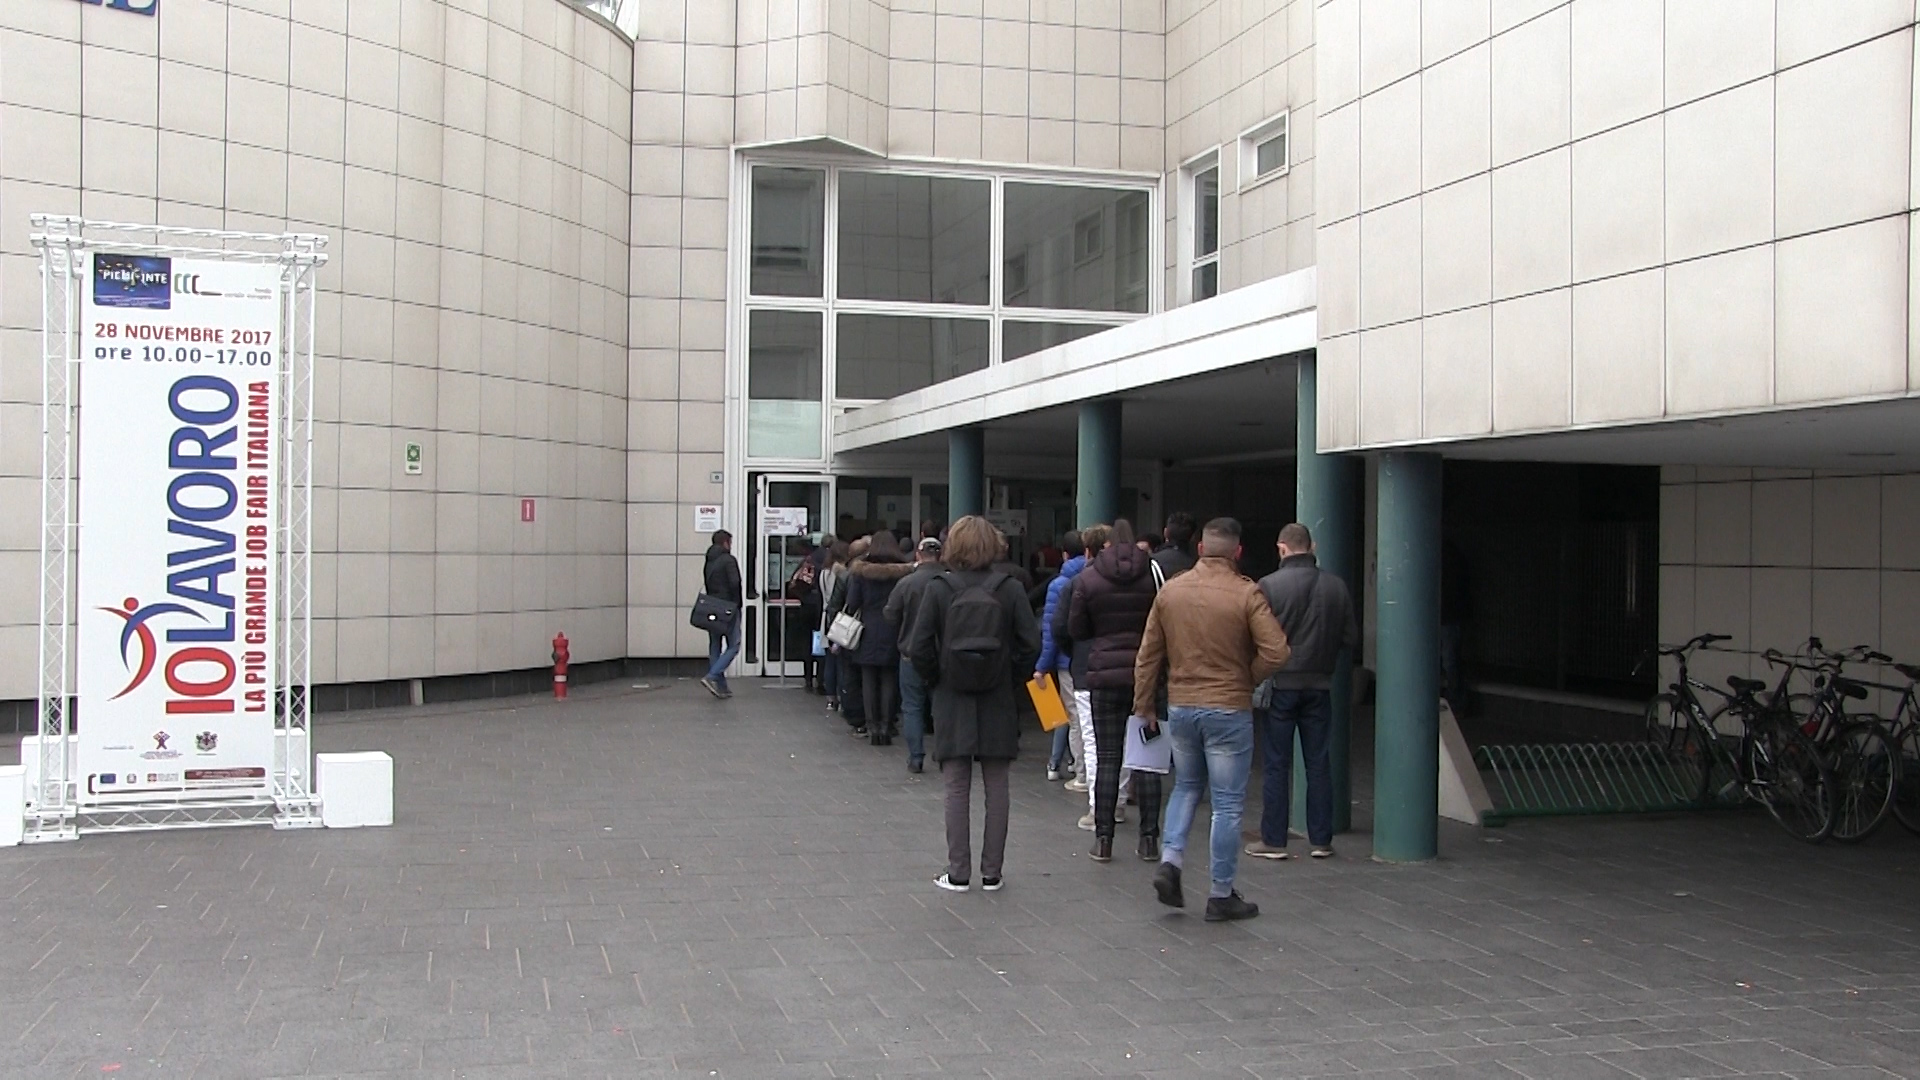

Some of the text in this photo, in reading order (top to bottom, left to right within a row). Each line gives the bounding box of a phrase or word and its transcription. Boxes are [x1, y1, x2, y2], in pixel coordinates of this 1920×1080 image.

[95, 323, 272, 345] 28 NOVEMBRE 2017
[95, 346, 272, 366] ore 10.00-17.00
[241, 381, 270, 712] LA PIÙ GRANDE JOB FAIR ITALIANA
